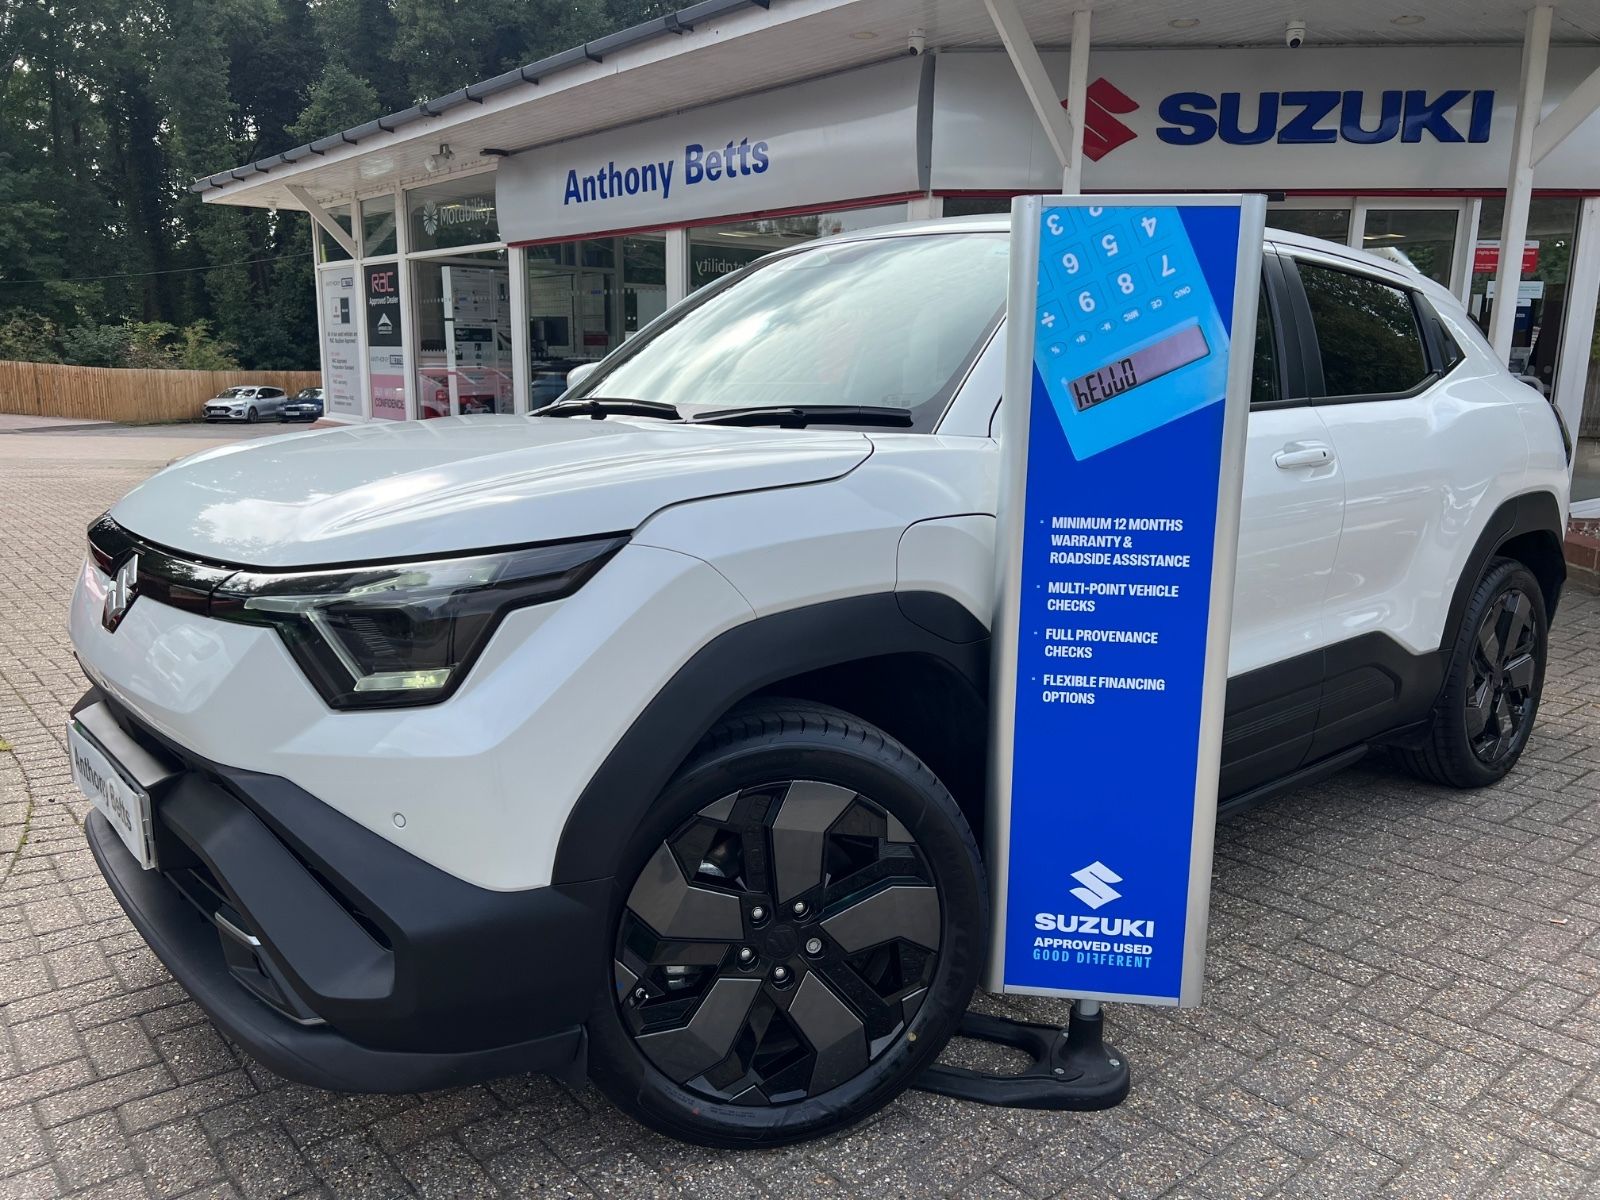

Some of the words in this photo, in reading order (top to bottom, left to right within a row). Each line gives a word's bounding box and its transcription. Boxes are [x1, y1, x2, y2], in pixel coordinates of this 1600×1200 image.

[1156, 89, 1496, 145] SUZUKI
[563, 159, 675, 206] Anthony
[684, 137, 770, 186] Betts
[440, 197, 492, 226] Motability
[1117, 273, 1134, 294] 8
[369, 296, 386, 307] Approved
[386, 295, 399, 304] Dealer
[1052, 516, 1112, 530] MINIMUM
[1113, 518, 1127, 530] 12
[1128, 518, 1183, 531] MONTHS
[1051, 534, 1121, 548] WARRANTY
[1123, 536, 1133, 548] &
[1050, 552, 1111, 565] ROADSIDE
[1112, 554, 1190, 567] ASSISTANCE
[1048, 581, 1127, 596] MULTI-POINT
[1128, 584, 1179, 598] VEHICLE
[1047, 599, 1096, 612] CHECKS
[1045, 628, 1075, 641] FULL
[1075, 630, 1158, 644] PROVENANCE
[1044, 645, 1093, 658] CHECKS
[1043, 674, 1097, 688] FLEXIBLE
[1098, 676, 1166, 691] FINANCING
[1042, 691, 1095, 704] OPTIONS
[74, 746, 110, 808] Anthony
[109, 784, 132, 832] Betts
[1034, 912, 1155, 938] SUZUKI
[1033, 937, 1111, 952] APPROVED
[1113, 943, 1153, 955] USED
[1033, 948, 1070, 962] GOOD
[1076, 953, 1152, 969] DIFFERENT
